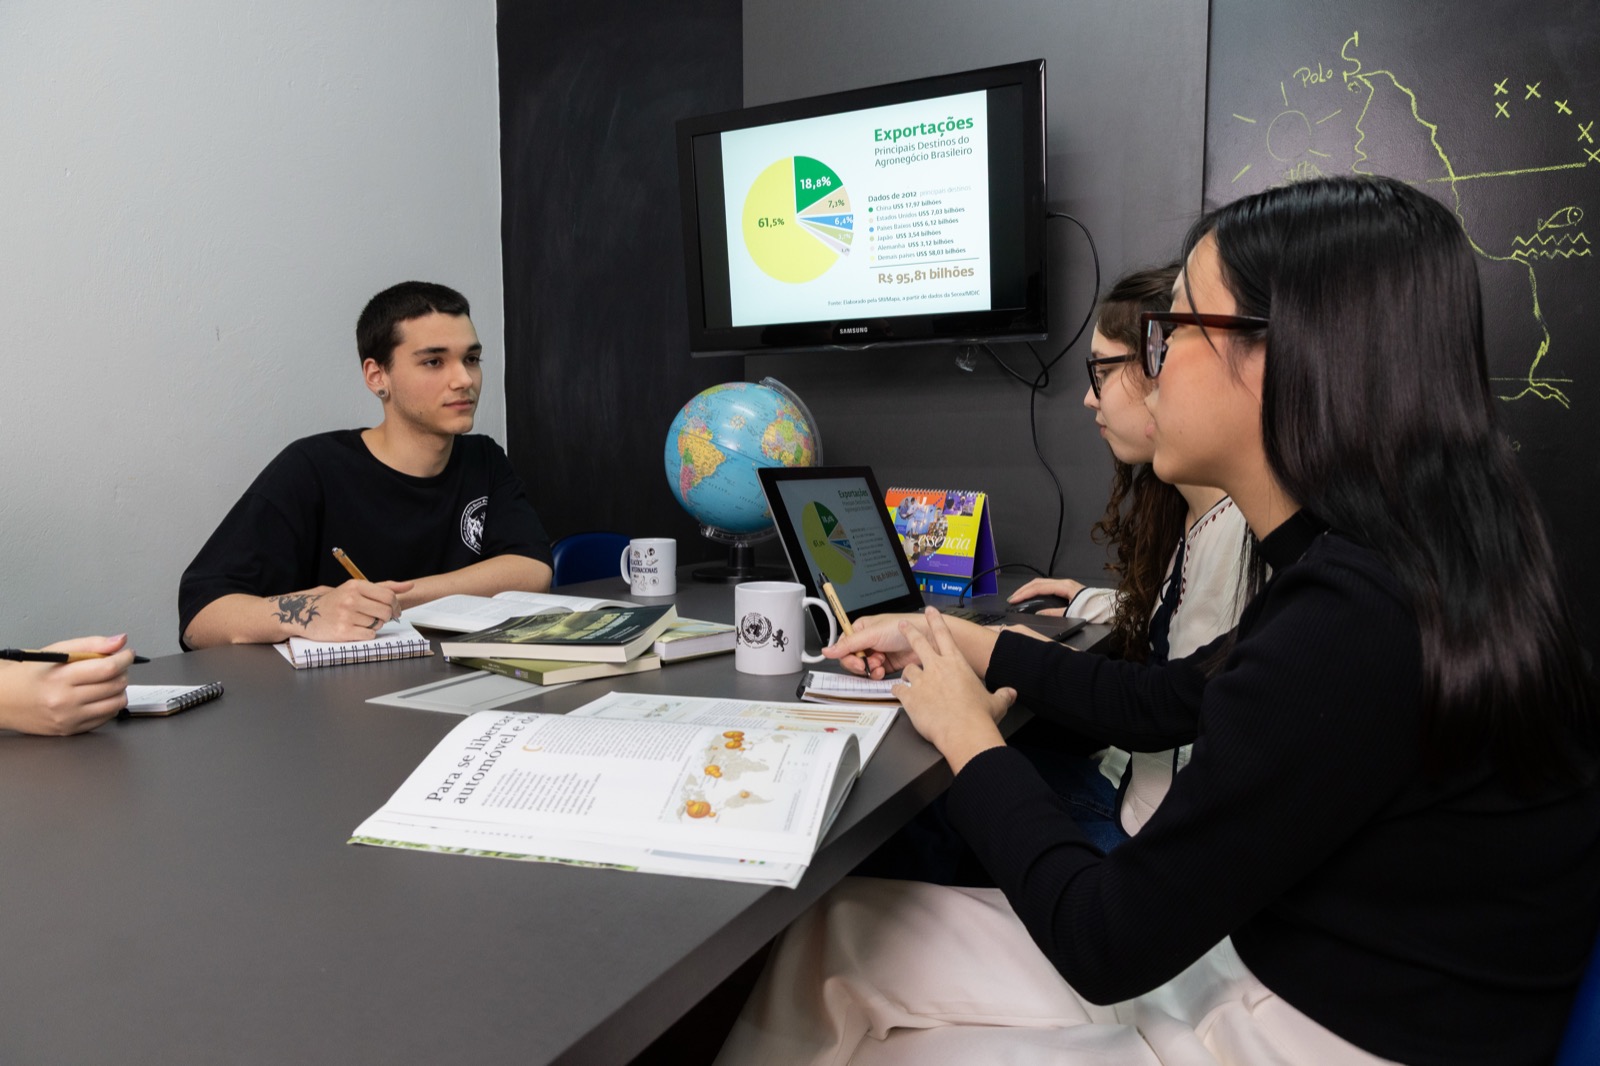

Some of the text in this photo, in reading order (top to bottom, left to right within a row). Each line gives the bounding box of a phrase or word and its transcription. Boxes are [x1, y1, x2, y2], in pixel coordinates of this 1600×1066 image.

[874, 116, 974, 143] Exportações
[874, 136, 970, 156] Principais Destinos do
[874, 147, 973, 168] Agronegócio Brasileiro
[799, 176, 832, 190] 18,8%
[868, 194, 890, 203] Dados
[901, 191, 917, 199] 2012
[876, 203, 892, 212] China
[921, 199, 942, 207] bilhões
[876, 213, 897, 222] Estados
[898, 212, 917, 220] Unidos
[944, 206, 965, 214] bilhões
[938, 217, 959, 225] bilhões
[758, 217, 785, 228] 61,5%
[877, 233, 893, 242] Japão
[921, 229, 942, 237] bilhões
[877, 242, 906, 251] Alemanha
[933, 238, 954, 246] bilhões
[877, 253, 898, 261] Demais
[945, 247, 966, 255] bilhões
[878, 266, 975, 284] R$ 95,81 bilhões
[839, 327, 868, 335] SAMSUNG
[918, 530, 971, 551] essência
[454, 734, 517, 804] automóvel
[425, 772, 463, 802] Para
[458, 755, 476, 768] se
